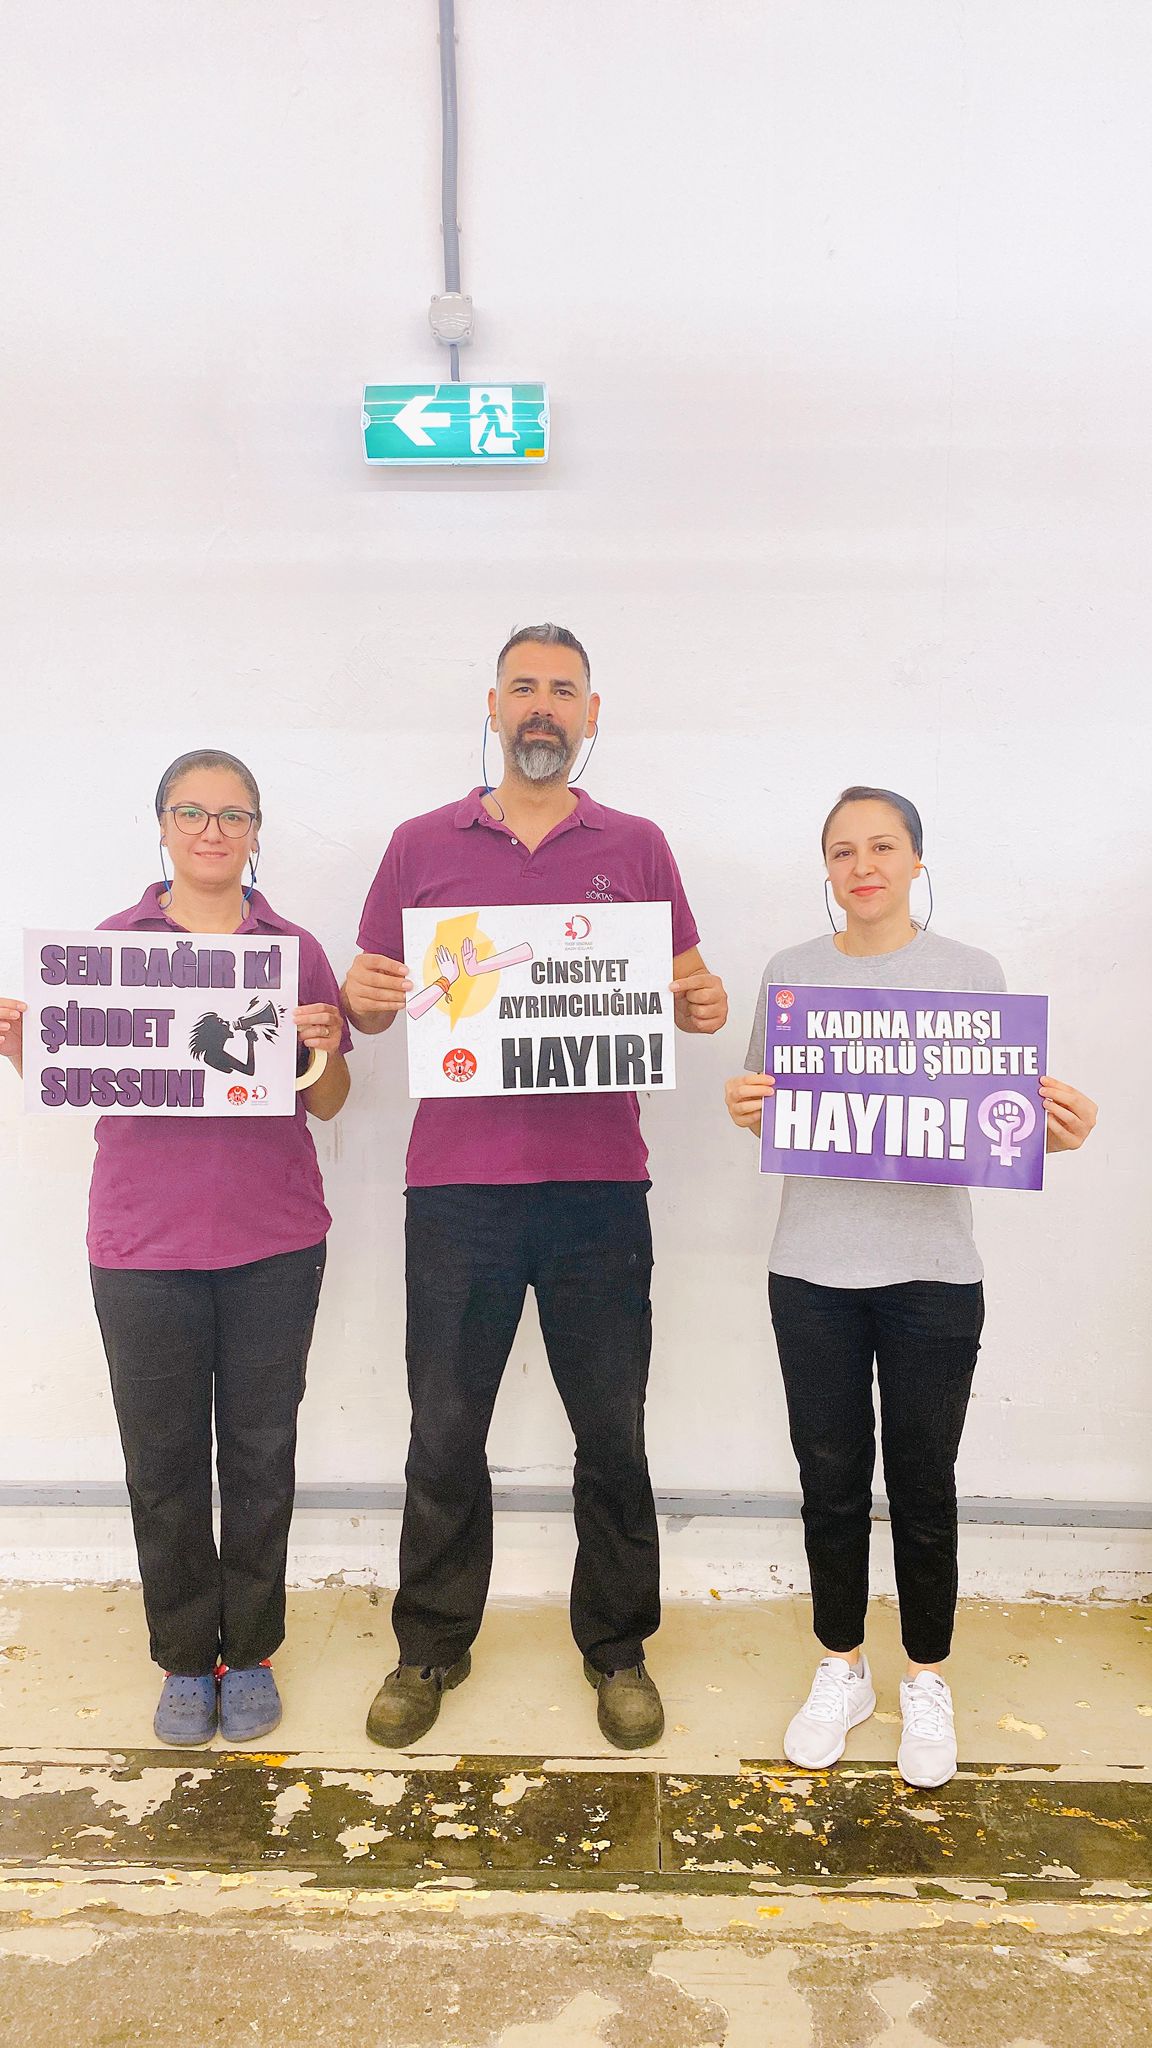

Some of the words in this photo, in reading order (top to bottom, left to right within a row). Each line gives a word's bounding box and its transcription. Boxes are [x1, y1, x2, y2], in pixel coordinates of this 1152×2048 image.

[40, 945, 112, 986] SEN
[121, 941, 236, 989] BAĞIR
[244, 945, 282, 989] Kİ
[531, 957, 629, 984] CİNSİYET
[499, 989, 663, 1019] AYRIMCILIĞINA
[40, 1000, 175, 1054] ŞİDDET
[806, 1010, 910, 1040] KADINA
[915, 1010, 1001, 1045] KARŞI
[501, 1033, 664, 1090] HAYIR!
[773, 1045, 825, 1074] HER
[830, 1040, 917, 1075] TÜRLÜ
[923, 1041, 1039, 1081] ŞİDDETE
[40, 1067, 205, 1108] SUSSUN!
[774, 1089, 969, 1161] HAYIR!
